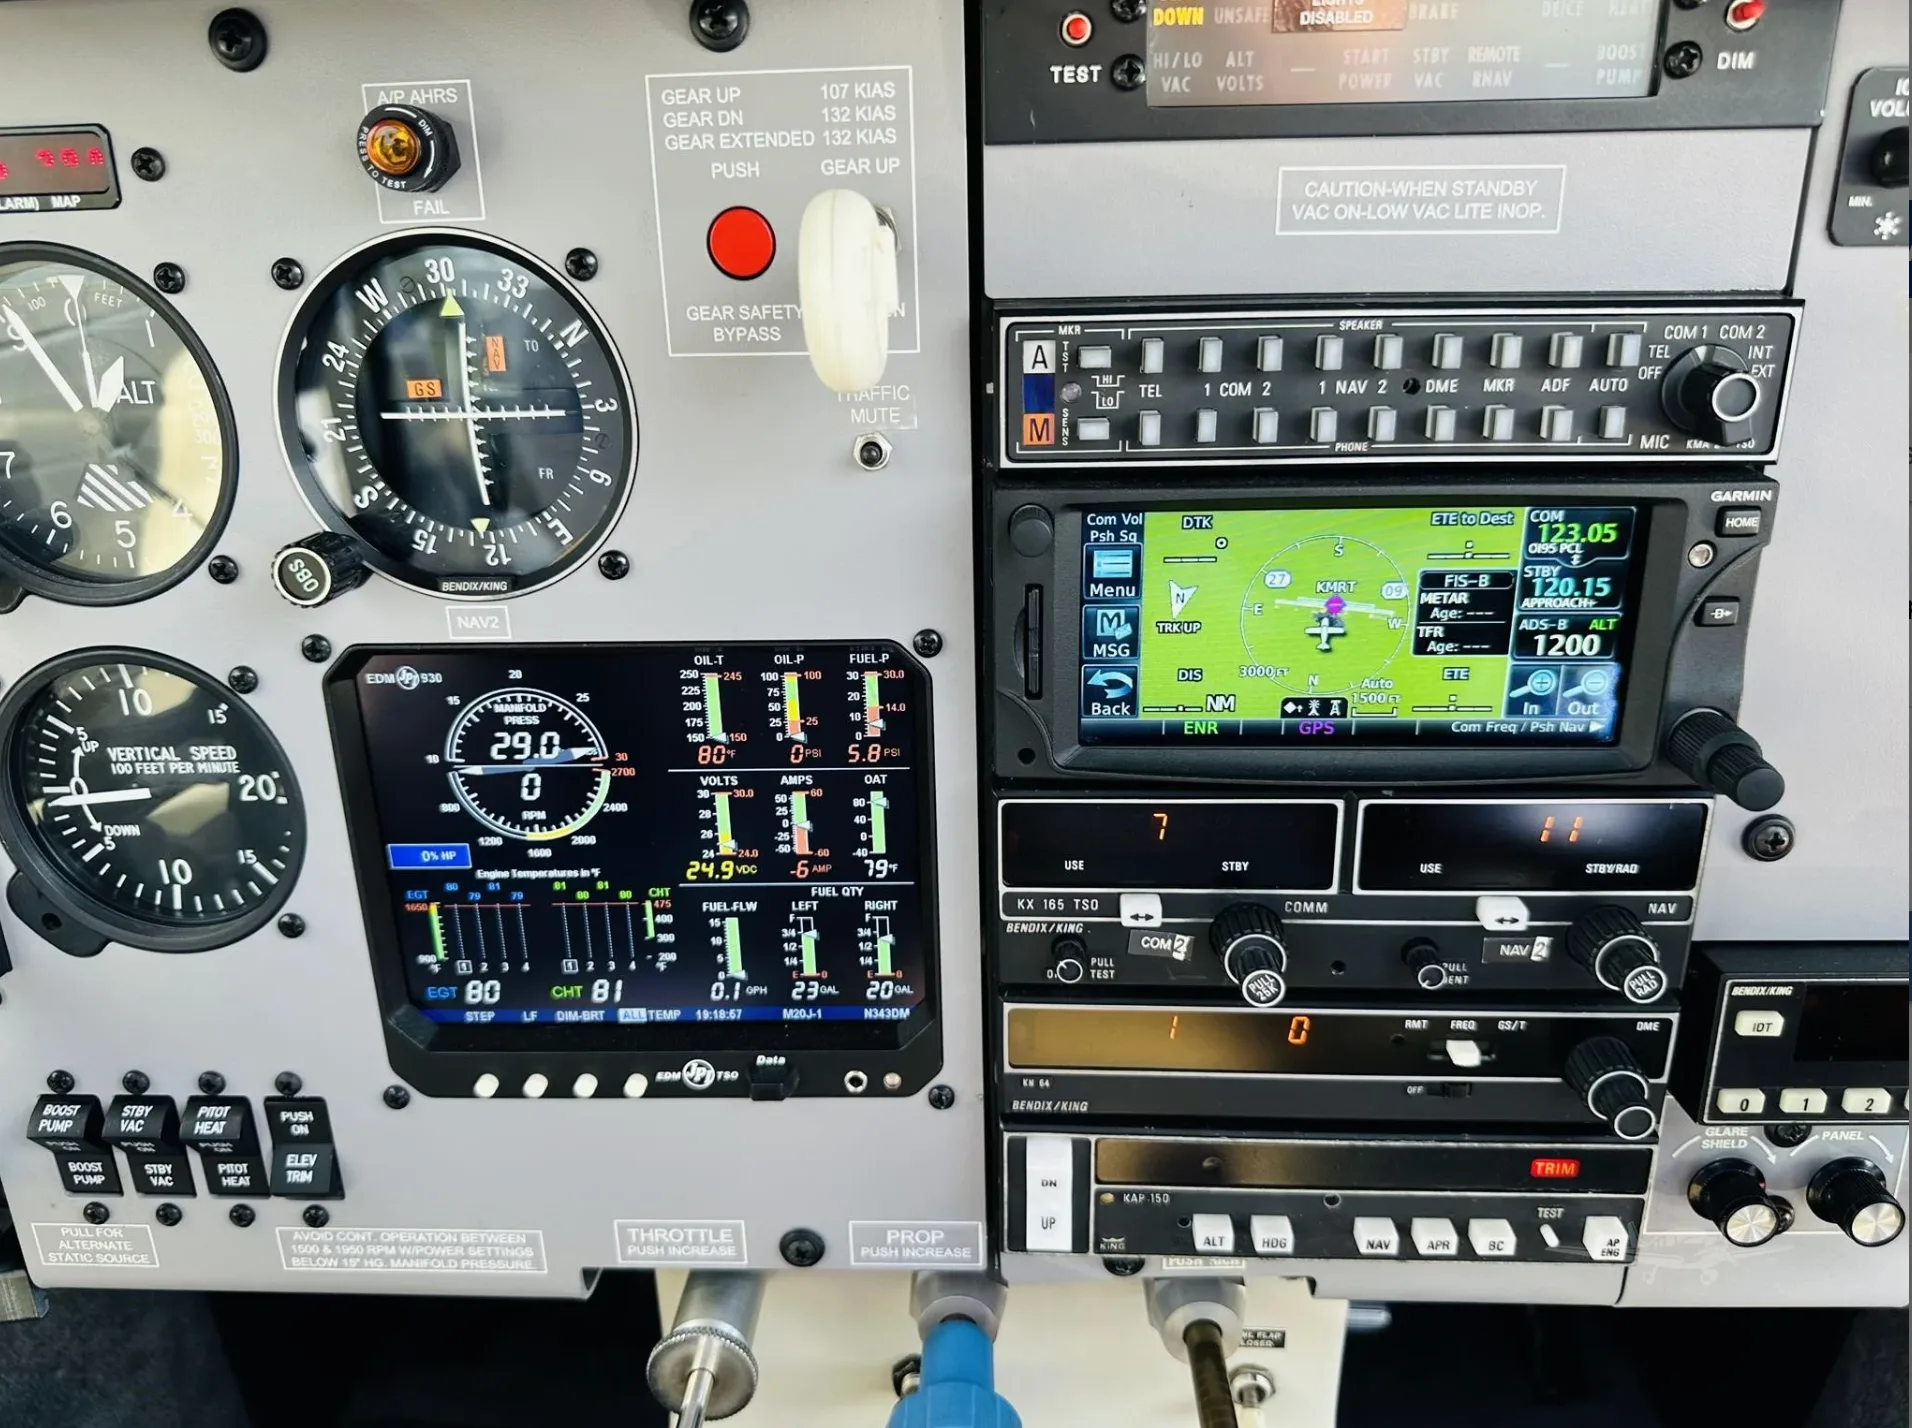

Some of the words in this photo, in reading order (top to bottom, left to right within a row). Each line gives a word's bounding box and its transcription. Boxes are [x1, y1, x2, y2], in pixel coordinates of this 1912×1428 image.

[1153, 51, 1202, 69] HI/LO
[1225, 51, 1254, 68] ALT
[1468, 46, 1520, 63] REMOTE
[1716, 51, 1756, 70] DIM
[1050, 65, 1102, 84] TEST
[1472, 70, 1513, 88] RNAV
[1162, 77, 1191, 93] VAC
[377, 90, 405, 106] A/P
[410, 88, 458, 104] AHRS
[661, 88, 712, 105] GEAR
[717, 87, 741, 103] UP
[820, 83, 849, 100] 107
[854, 82, 896, 98] KIAS
[664, 135, 715, 151] GEAR
[719, 131, 815, 149] EXTENDED
[822, 130, 852, 146] 132
[856, 128, 897, 144] KIAS
[711, 161, 760, 179] PUSH
[821, 159, 871, 176] GEAR
[876, 157, 900, 174] UP
[1305, 181, 1448, 198] CAUTION-WHEN
[1452, 180, 1538, 197] STANDBY
[50, 195, 81, 208] MAP
[413, 200, 450, 215] FAIL
[1292, 204, 1329, 220] VAC
[1334, 204, 1408, 220] ON-LOW
[1412, 204, 1450, 219] VAC
[1454, 203, 1492, 219] LITE
[1496, 203, 1546, 219] INOP.
[424, 256, 456, 284] 30
[1058, 326, 1081, 336] MKR
[1339, 320, 1383, 331] SPEAKER
[560, 318, 589, 348] N
[713, 326, 782, 343] BYPASS
[322, 340, 349, 374] 24
[1649, 345, 1671, 358] TEL
[1748, 345, 1773, 359] INT
[1638, 366, 1662, 380] OFF
[1139, 385, 1163, 398] TEL
[1425, 379, 1460, 393] DME
[1483, 378, 1516, 392] MKR
[1541, 378, 1572, 392] ADF
[1589, 378, 1629, 392] AUTO
[116, 381, 156, 404] ALT
[850, 408, 900, 424] MUTE
[1640, 435, 1670, 449] MIC
[539, 467, 554, 480] FR
[1711, 490, 1772, 502] GARMIN
[50, 500, 73, 529] 6
[1087, 514, 1117, 525] Com
[1122, 513, 1143, 525] Vol
[1530, 510, 1564, 522] COM
[1182, 516, 1213, 529] DTK
[1725, 516, 1760, 528] HOME
[115, 520, 137, 548] 5
[1090, 530, 1115, 542] Psh
[1119, 530, 1138, 543] Sq
[1538, 523, 1618, 543] 123.05
[1524, 565, 1560, 577] STBY
[441, 579, 509, 593] BENDIX/KING
[1090, 584, 1136, 597] Menu
[1316, 581, 1357, 594] KMRT
[1531, 577, 1612, 597] 120.15
[1420, 592, 1470, 604] METAR
[457, 615, 500, 630] NAV2
[1417, 626, 1445, 638] TFR
[1093, 643, 1130, 658] MSG
[1532, 633, 1601, 656] 1200
[693, 655, 724, 666] OIL-T
[774, 654, 805, 665] OIL-P
[849, 653, 890, 664] FUEL-P
[1177, 669, 1203, 681] DIS
[1442, 667, 1470, 680] ETE
[1361, 677, 1394, 689] Auto
[119, 687, 152, 716] 10
[492, 703, 547, 713] MANIFOLD
[1206, 695, 1235, 712] NM
[1091, 702, 1131, 716] Back
[1523, 702, 1541, 715] In
[1568, 702, 1600, 715] Out
[504, 715, 540, 726] PRESS
[1184, 721, 1219, 735] ENR
[1298, 721, 1336, 735] GPS
[489, 731, 560, 761] 29.0
[106, 746, 180, 762] VERTICAL
[190, 745, 238, 760] SPEED
[848, 743, 881, 763] 5.8
[883, 747, 901, 757] PSI
[699, 776, 739, 786] VOLTS
[780, 775, 813, 785] AMPS
[864, 774, 888, 784] OAT
[238, 774, 278, 801] 20
[520, 773, 542, 801] 0
[522, 810, 547, 821] RPM
[104, 824, 141, 837] DOWN
[159, 858, 193, 885] 10
[686, 861, 734, 880] 24.9
[735, 865, 758, 874] VDC
[1221, 861, 1249, 872] STBY
[1420, 863, 1443, 874] USE
[811, 887, 839, 897] FUEL
[842, 886, 864, 897] QTY
[702, 901, 758, 912] FUEL-FLW
[791, 900, 819, 911] LEFT
[864, 900, 898, 911] RIGHT
[1284, 901, 1328, 914] COMM
[1648, 902, 1678, 914] NAV
[1006, 922, 1083, 934] BENDIX/KING
[1090, 957, 1115, 967] PULL
[1090, 969, 1115, 979] TEST
[426, 987, 458, 999] EGT
[464, 980, 501, 1004] 80
[465, 1011, 495, 1022] STEP
[556, 1010, 606, 1021] DIM-BRT
[782, 1008, 822, 1019] M20J-1
[863, 1008, 910, 1019] N343DM
[1404, 1019, 1429, 1030] RMT
[1450, 1019, 1478, 1031] FREQ
[1497, 1020, 1527, 1031] GS/T
[1636, 1021, 1660, 1032] DME
[1752, 1021, 1773, 1033] IDT
[756, 1055, 786, 1066] Data
[41, 1104, 81, 1117] BOOST
[121, 1105, 153, 1117] STBY
[197, 1105, 231, 1117] PITOT
[1011, 1100, 1089, 1112] BENDIX/KING
[38, 1119, 73, 1133] PUMP
[1704, 1127, 1748, 1138] GLARE
[1821, 1130, 1864, 1141] PANEL
[1701, 1139, 1748, 1149] SHIELD
[68, 1162, 103, 1173] BOOST
[144, 1163, 172, 1175] STBY
[218, 1163, 248, 1174] PITOT
[1535, 1161, 1576, 1176] TRIM
[73, 1174, 105, 1185] PUMP
[150, 1176, 174, 1187] VAC
[221, 1176, 251, 1187] HEAT
[286, 1170, 313, 1183] TRIM
[1537, 1207, 1564, 1218] TEST
[1041, 1216, 1056, 1230] UP
[61, 1227, 93, 1238] PULL
[95, 1227, 124, 1238] FOR
[627, 1228, 733, 1243] THROTTLE
[886, 1230, 945, 1244] PROP
[58, 1239, 133, 1251] ALTERNATE
[1202, 1236, 1225, 1247] ALT
[1261, 1237, 1287, 1249] HDG
[1606, 1238, 1621, 1247] AP
[48, 1253, 94, 1264] STATIC
[96, 1253, 150, 1264] SOURCE
